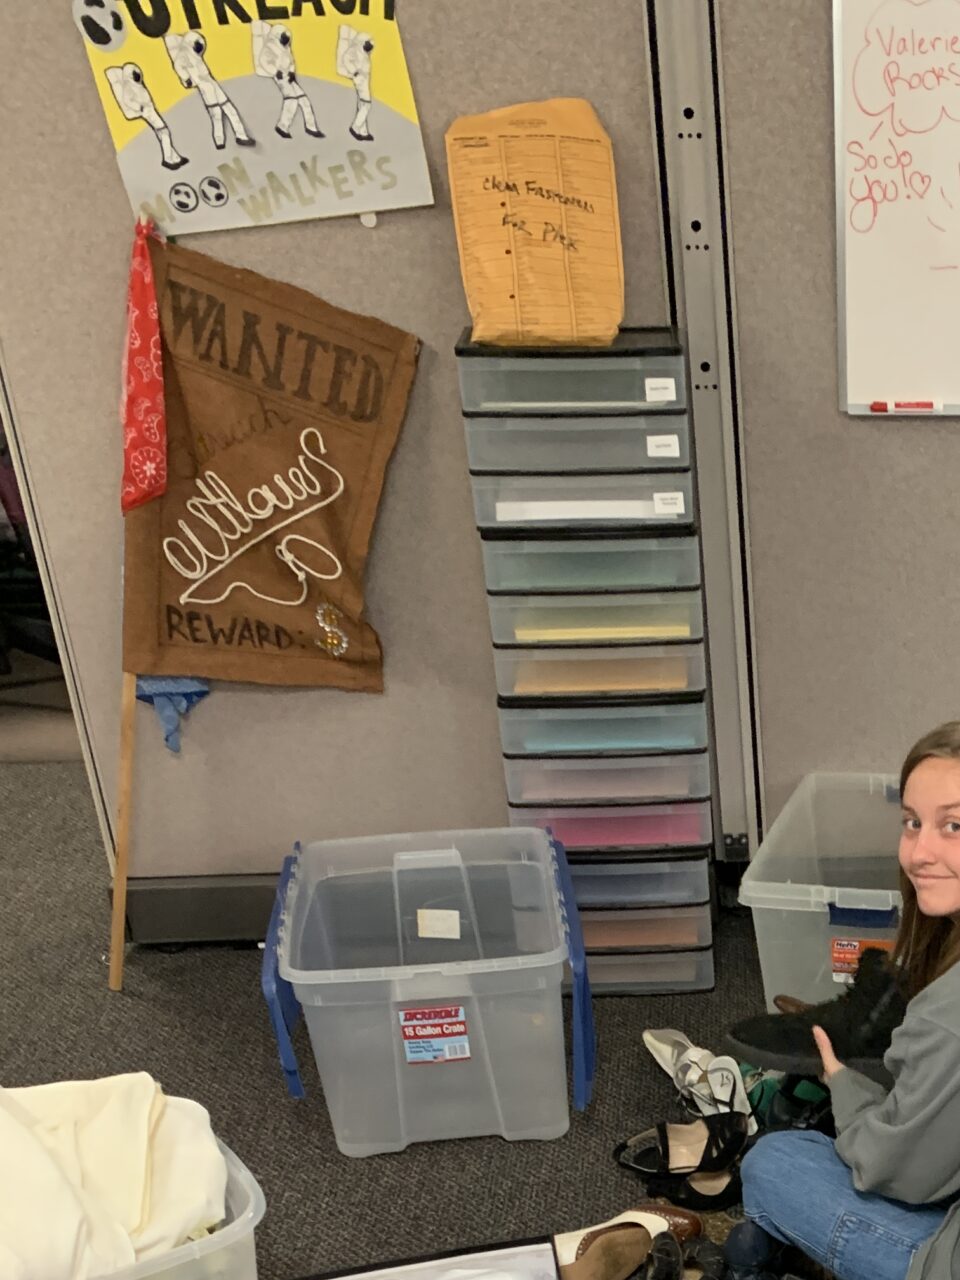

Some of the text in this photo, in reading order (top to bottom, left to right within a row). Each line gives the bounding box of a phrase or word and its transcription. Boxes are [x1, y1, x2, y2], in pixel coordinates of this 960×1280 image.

[847, 138, 912, 172] So do
[237, 149, 398, 225] WALKERS
[167, 278, 384, 423] WANTED
[835, 941, 859, 949] Hefty
[404, 1023, 466, 1037] 15 Gallon Crate
